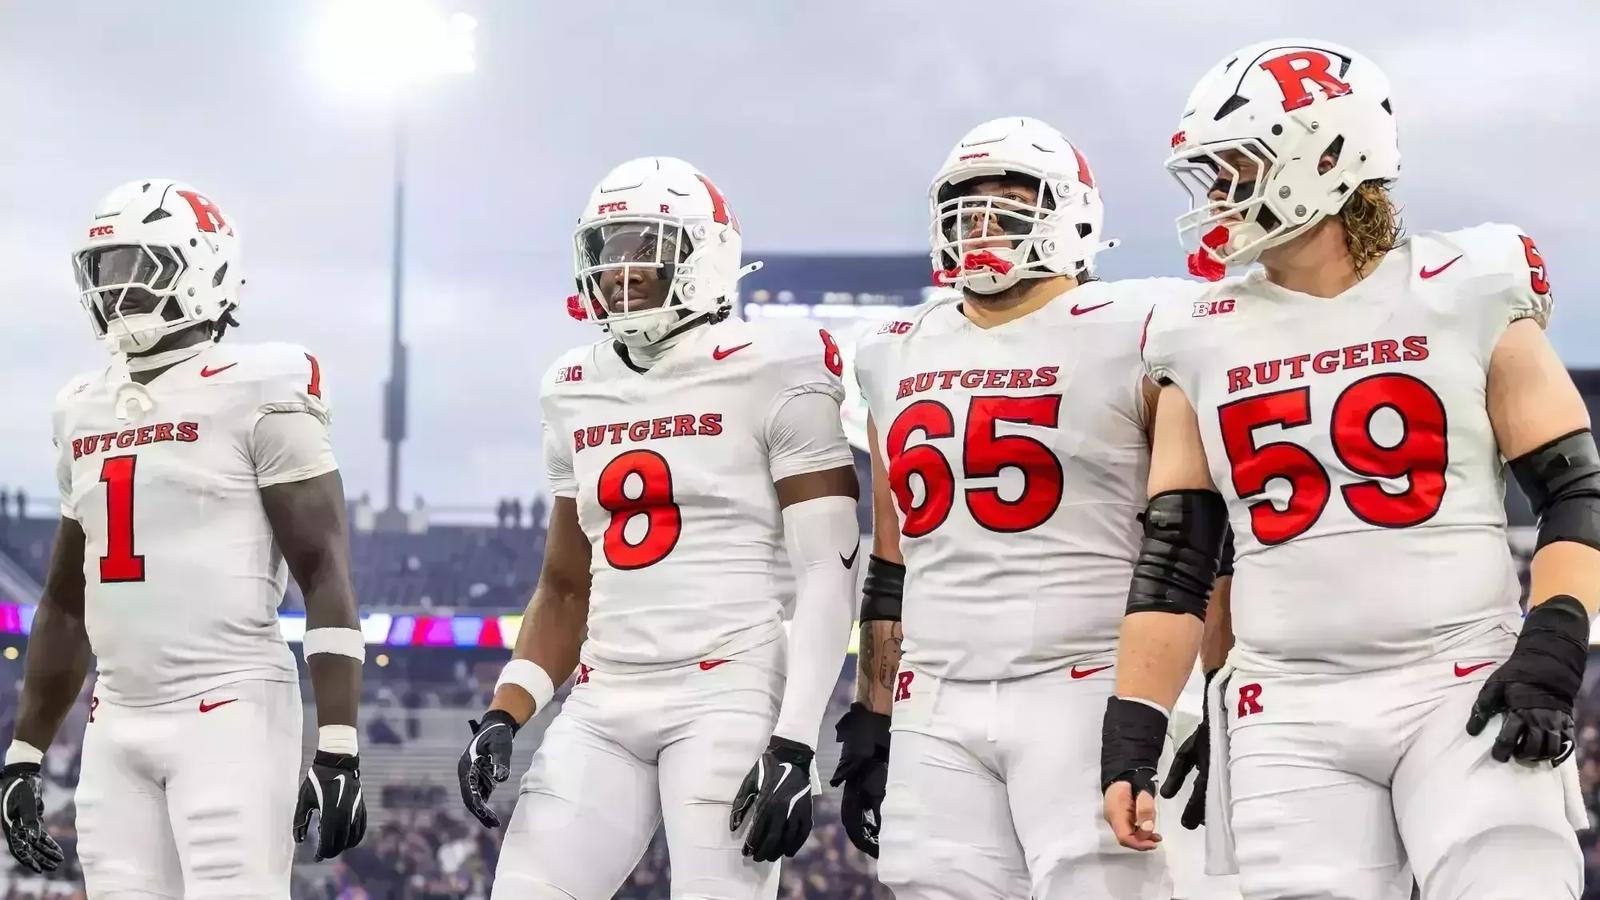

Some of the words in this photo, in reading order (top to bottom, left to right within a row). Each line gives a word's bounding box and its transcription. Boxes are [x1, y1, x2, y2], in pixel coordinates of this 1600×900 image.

[1260, 50, 1353, 112] R
[176, 190, 234, 237] R
[660, 203, 670, 214] R
[1191, 299, 1236, 317] BIG
[304, 352, 322, 400] 1
[896, 365, 1062, 401] RUTGERS
[1227, 335, 1430, 394] RUTGERS
[71, 421, 200, 460] RUTGERS
[573, 412, 723, 453] RUTGERS
[886, 393, 1064, 538] 65
[1217, 372, 1449, 546] 59
[97, 453, 146, 584] 1
[597, 448, 682, 571] 8
[895, 670, 915, 702] R
[1237, 682, 1264, 719] R
